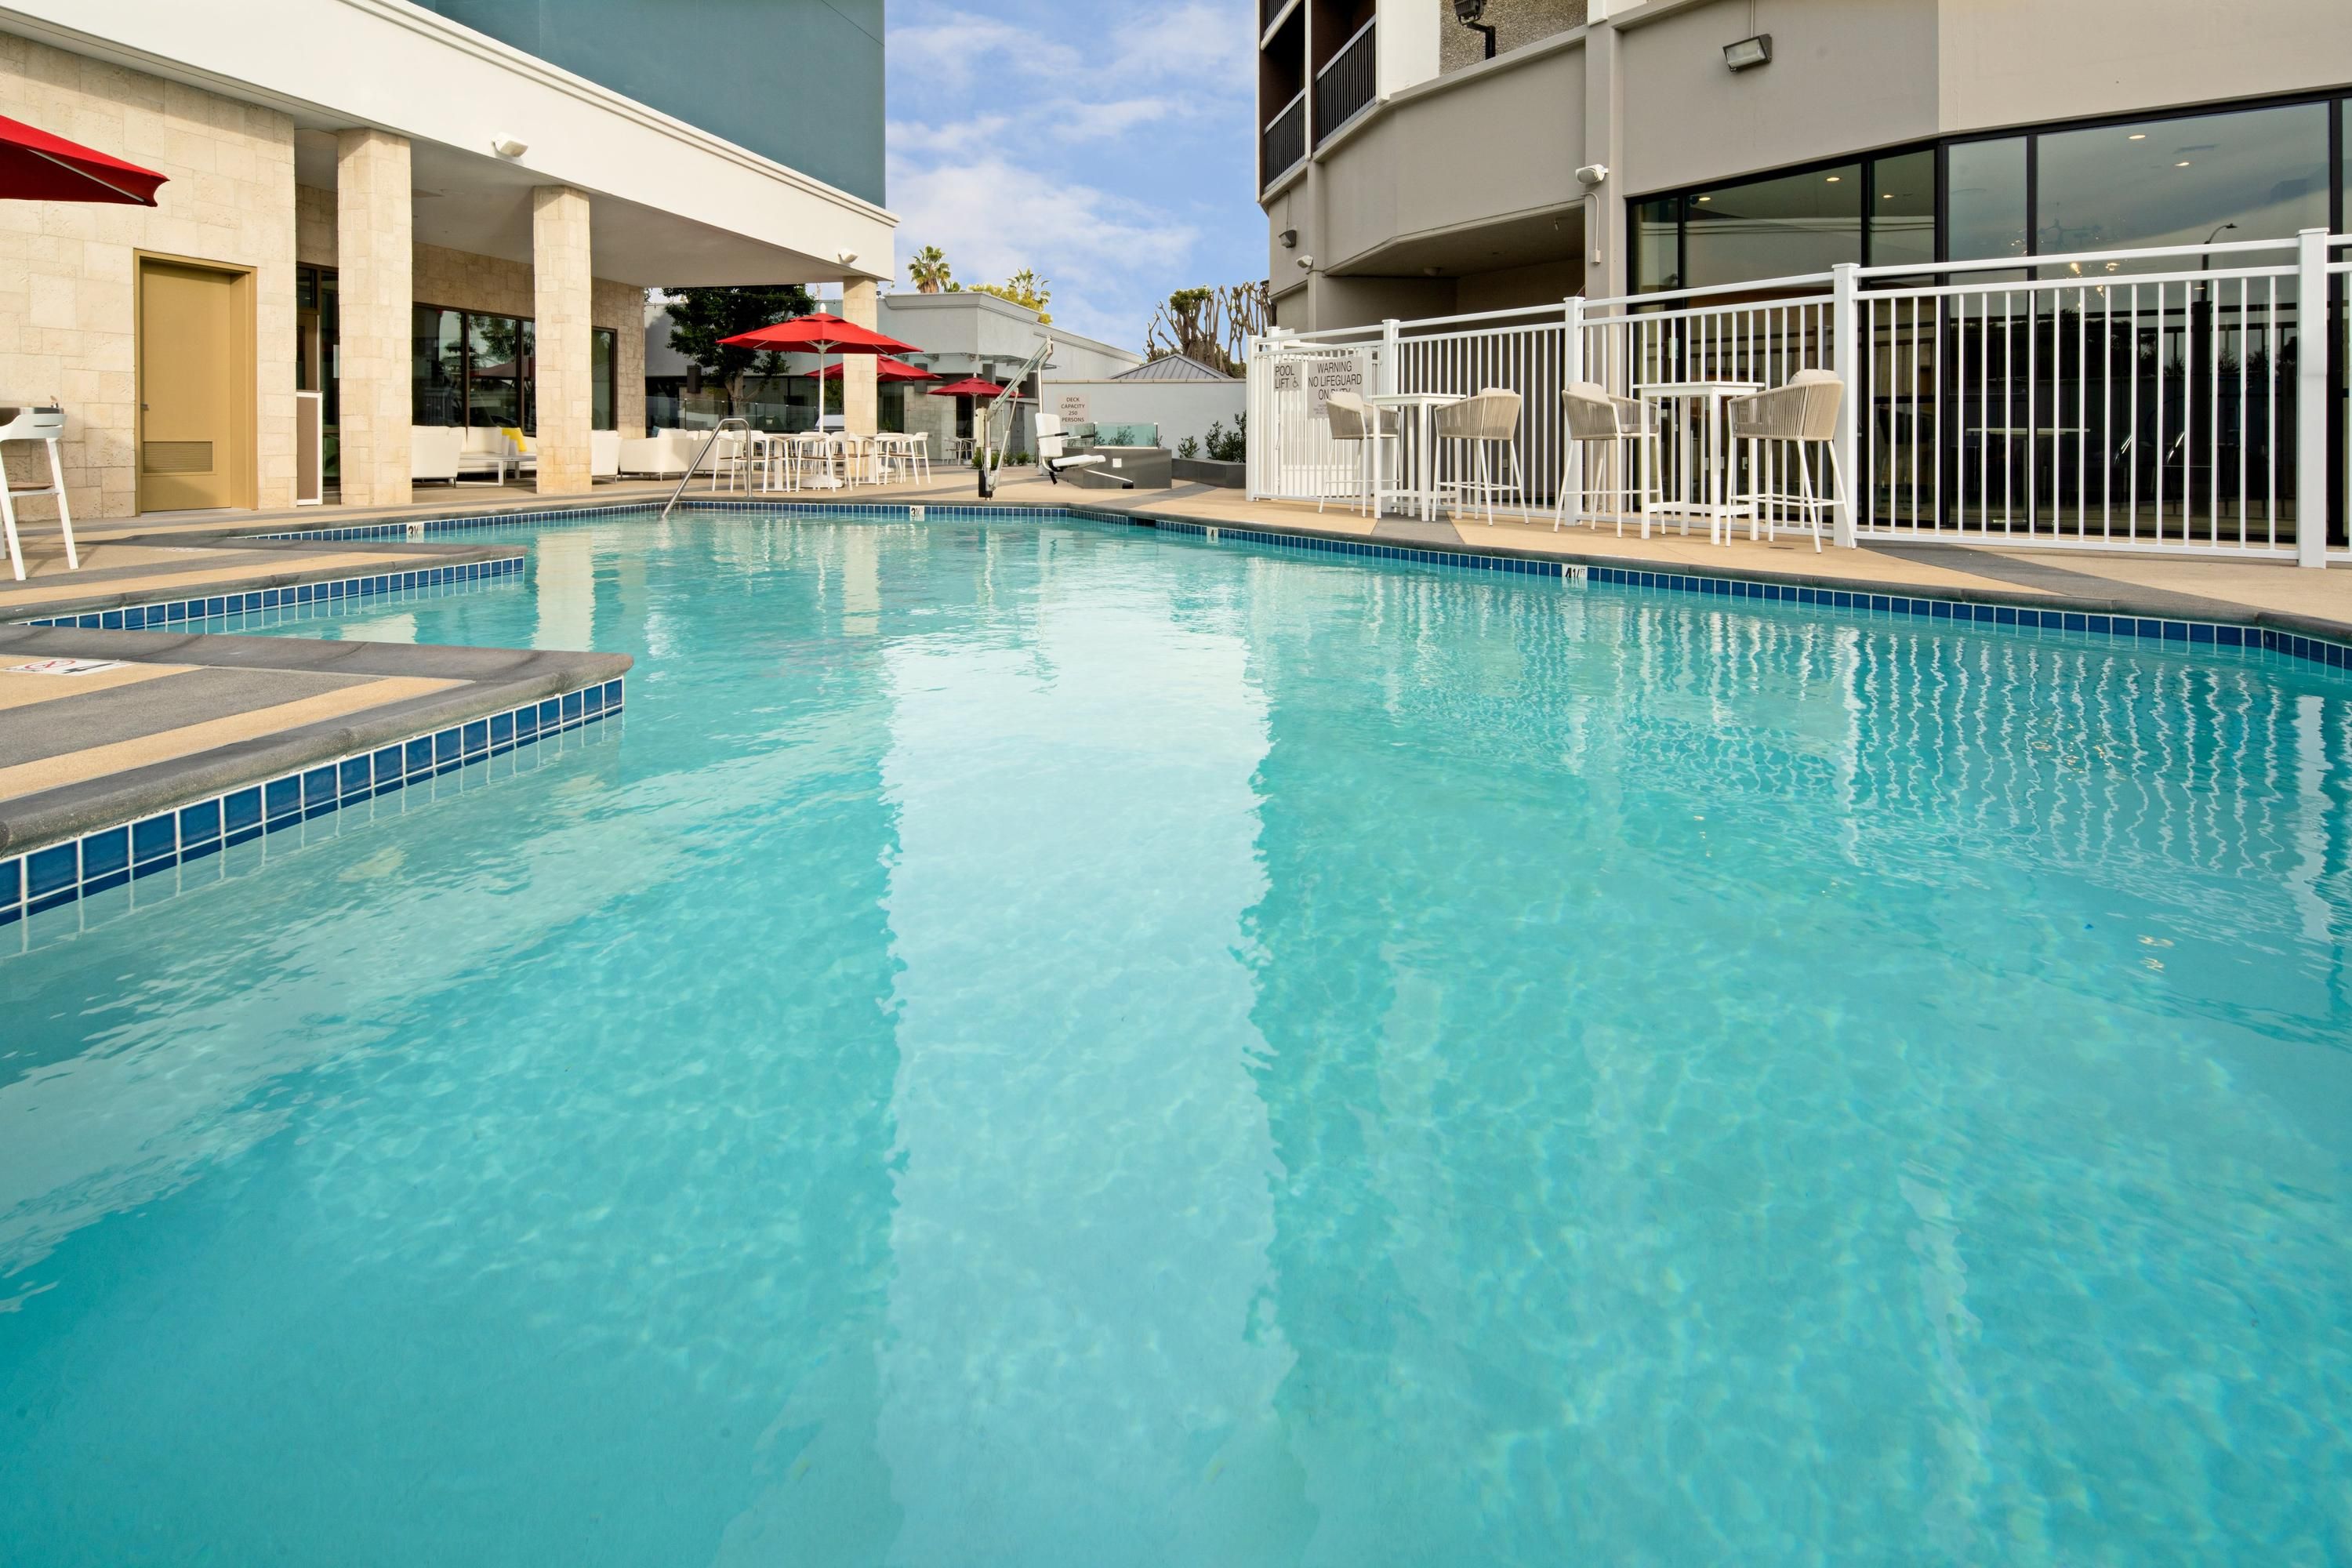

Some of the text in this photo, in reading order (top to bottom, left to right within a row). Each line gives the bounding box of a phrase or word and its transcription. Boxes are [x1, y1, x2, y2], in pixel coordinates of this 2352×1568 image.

[1275, 365, 1295, 376] POOL
[1317, 361, 1352, 374] WARNING
[1275, 378, 1290, 389] LIFT
[1308, 373, 1363, 387] NO LIFEGUARD
[1318, 389, 1330, 401] ON
